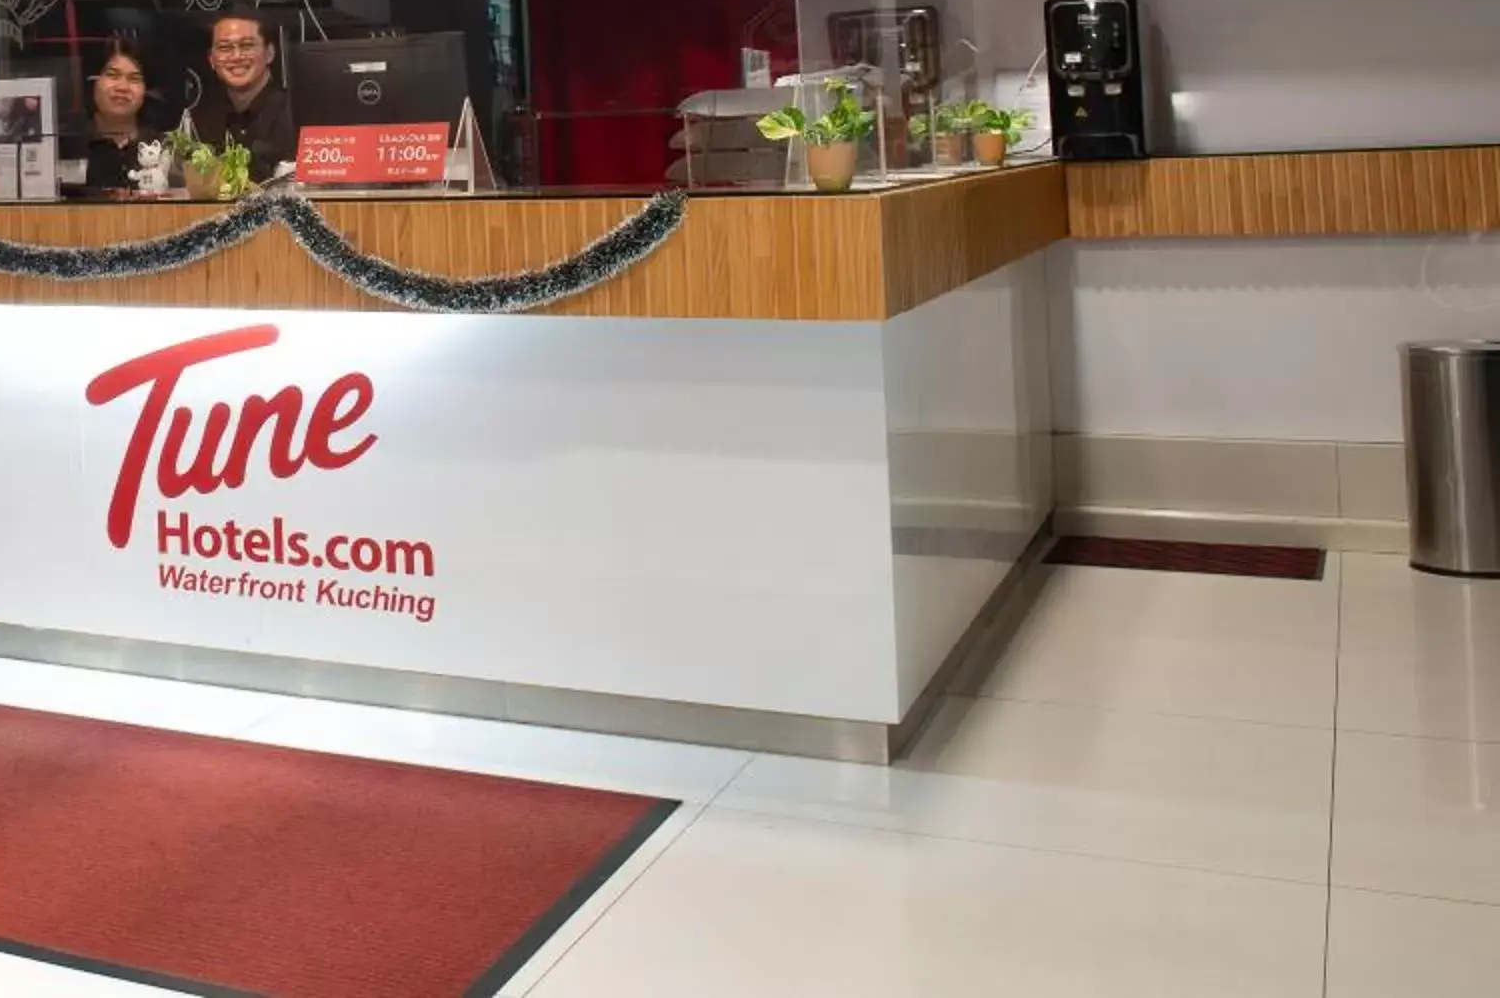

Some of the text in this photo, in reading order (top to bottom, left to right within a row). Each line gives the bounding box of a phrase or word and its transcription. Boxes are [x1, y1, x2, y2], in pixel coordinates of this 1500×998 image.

[85, 323, 378, 548] Tune
[157, 509, 434, 577] Hotels.com
[158, 564, 436, 623] Waterfront Kuching
